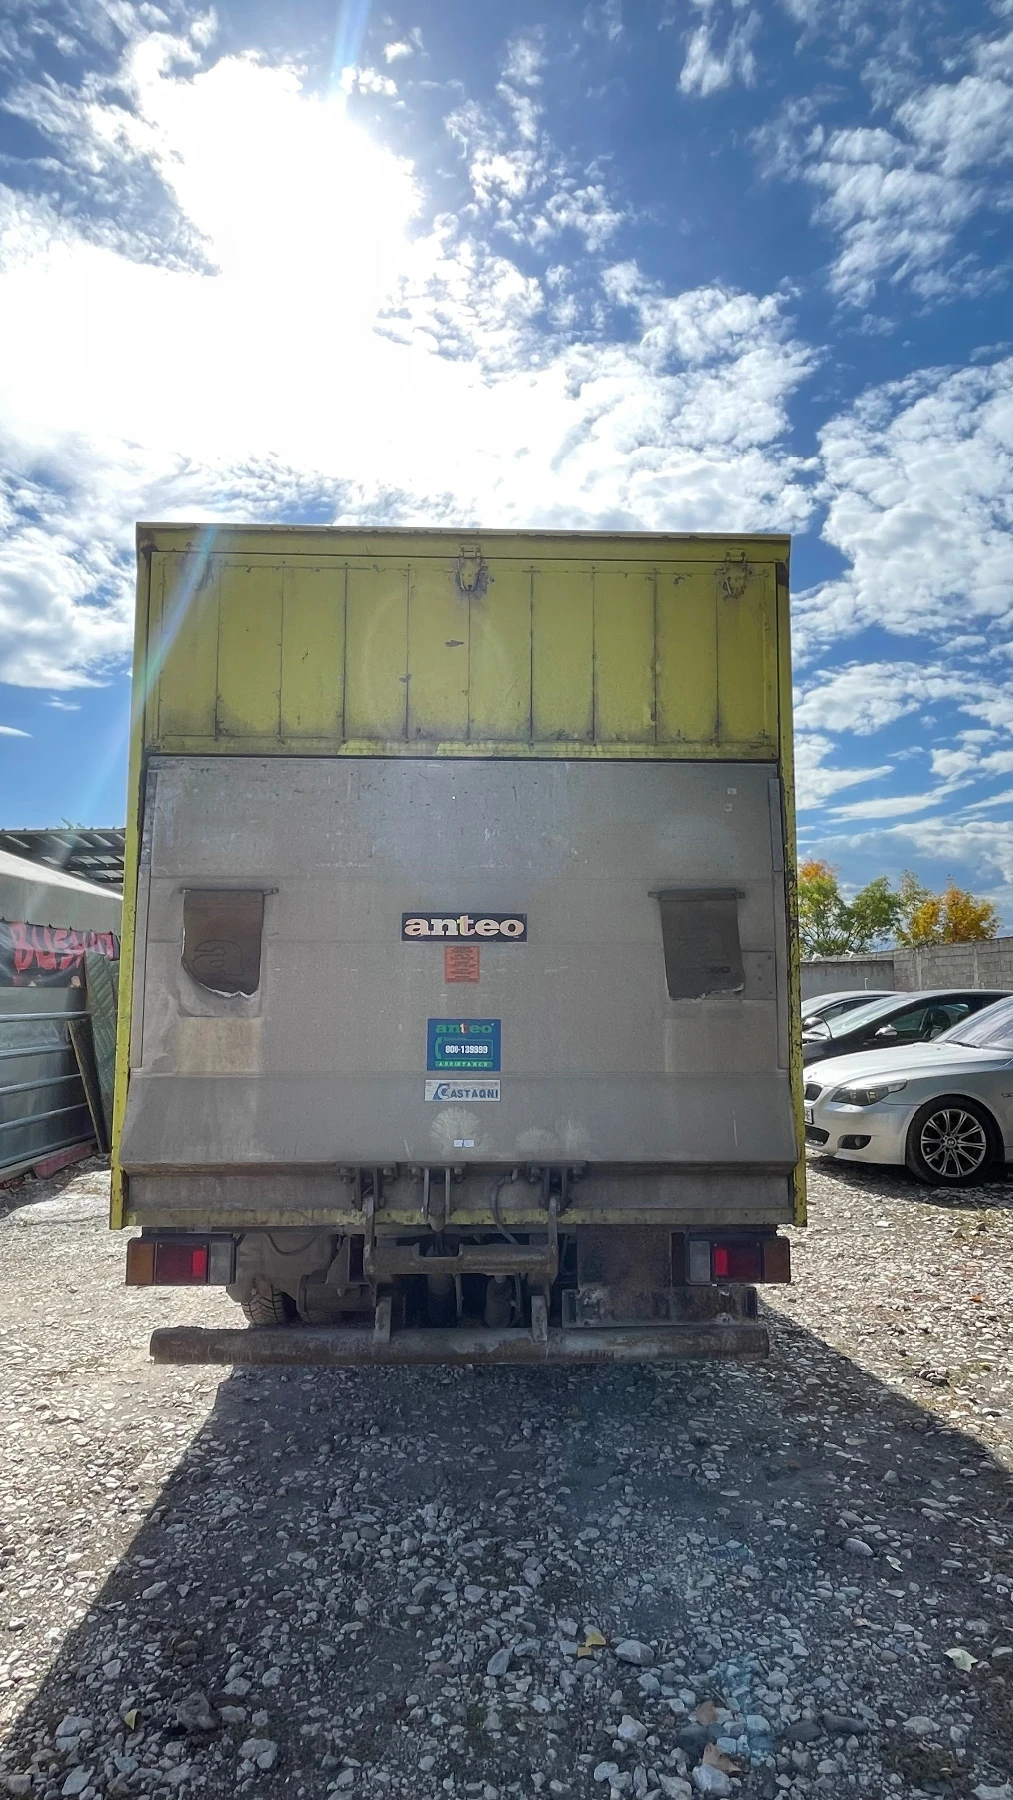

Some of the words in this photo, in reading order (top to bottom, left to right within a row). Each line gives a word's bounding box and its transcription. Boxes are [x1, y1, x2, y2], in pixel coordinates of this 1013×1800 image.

[405, 915, 524, 937] anteo
[436, 1023, 492, 1033] anteo
[433, 1083, 499, 1100] CASTAGNI
